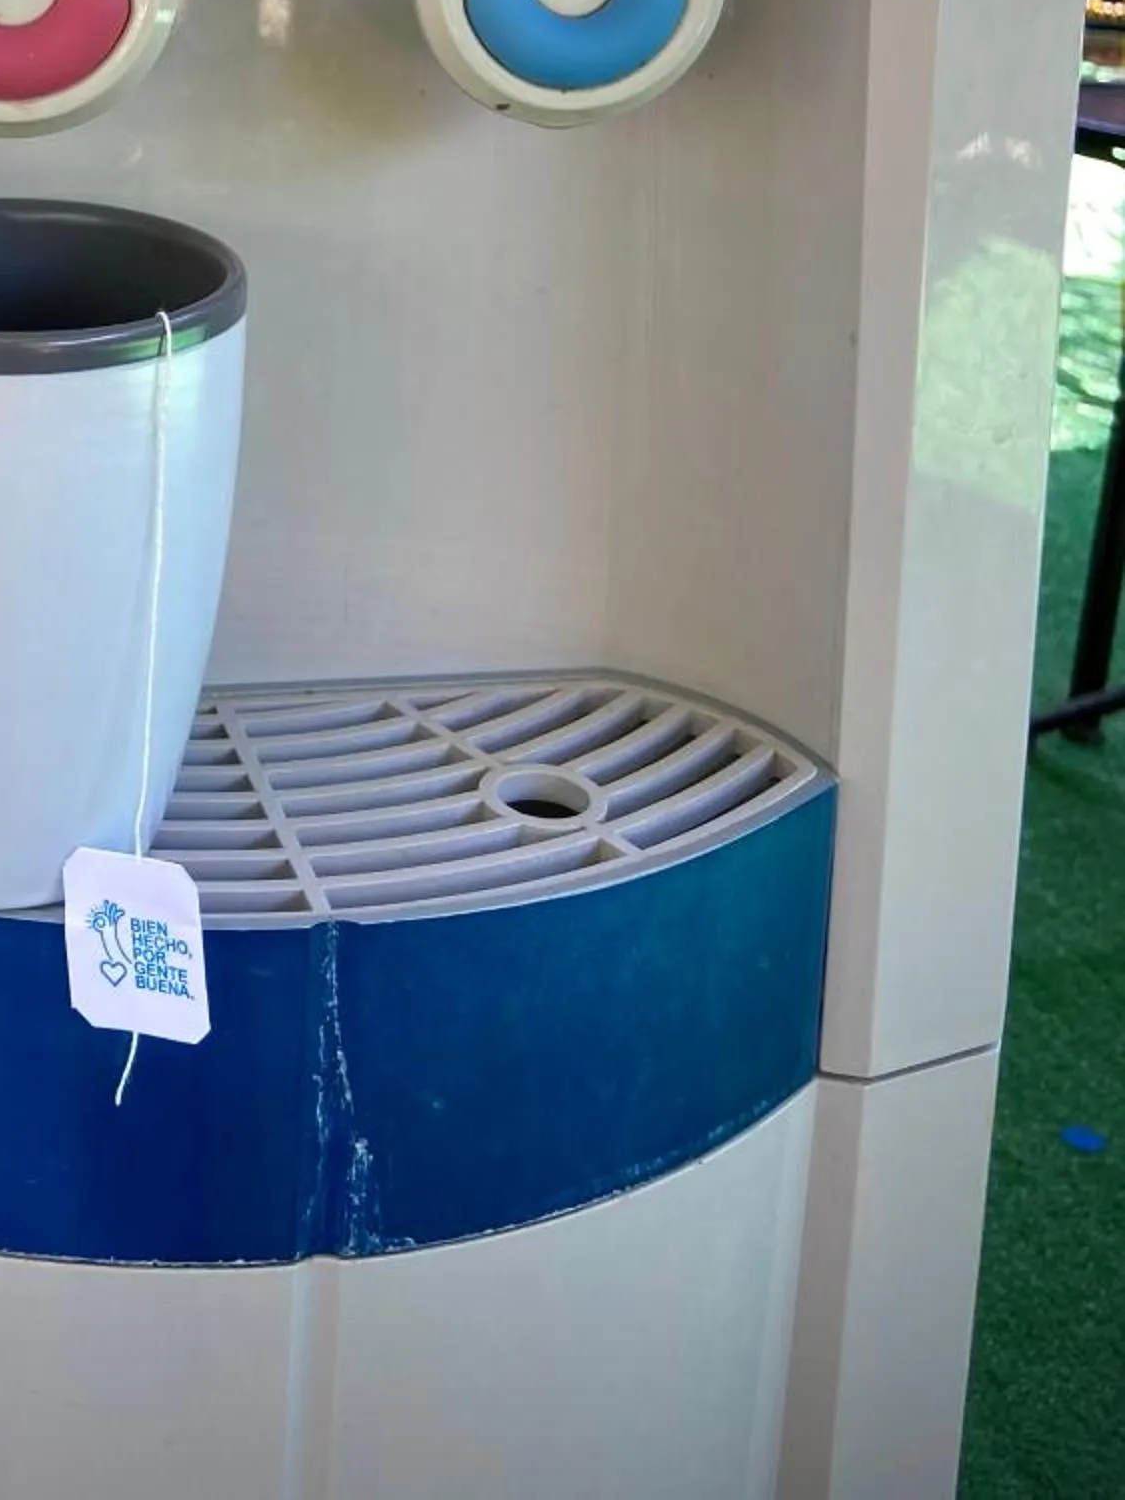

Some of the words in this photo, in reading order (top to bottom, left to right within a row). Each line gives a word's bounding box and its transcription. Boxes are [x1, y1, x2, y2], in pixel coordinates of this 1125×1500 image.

[130, 917, 168, 936] BIEN
[132, 933, 193, 959] HECHO,
[133, 947, 167, 965] POR
[134, 961, 188, 983] GENTE
[135, 975, 195, 1000] BUENA.
